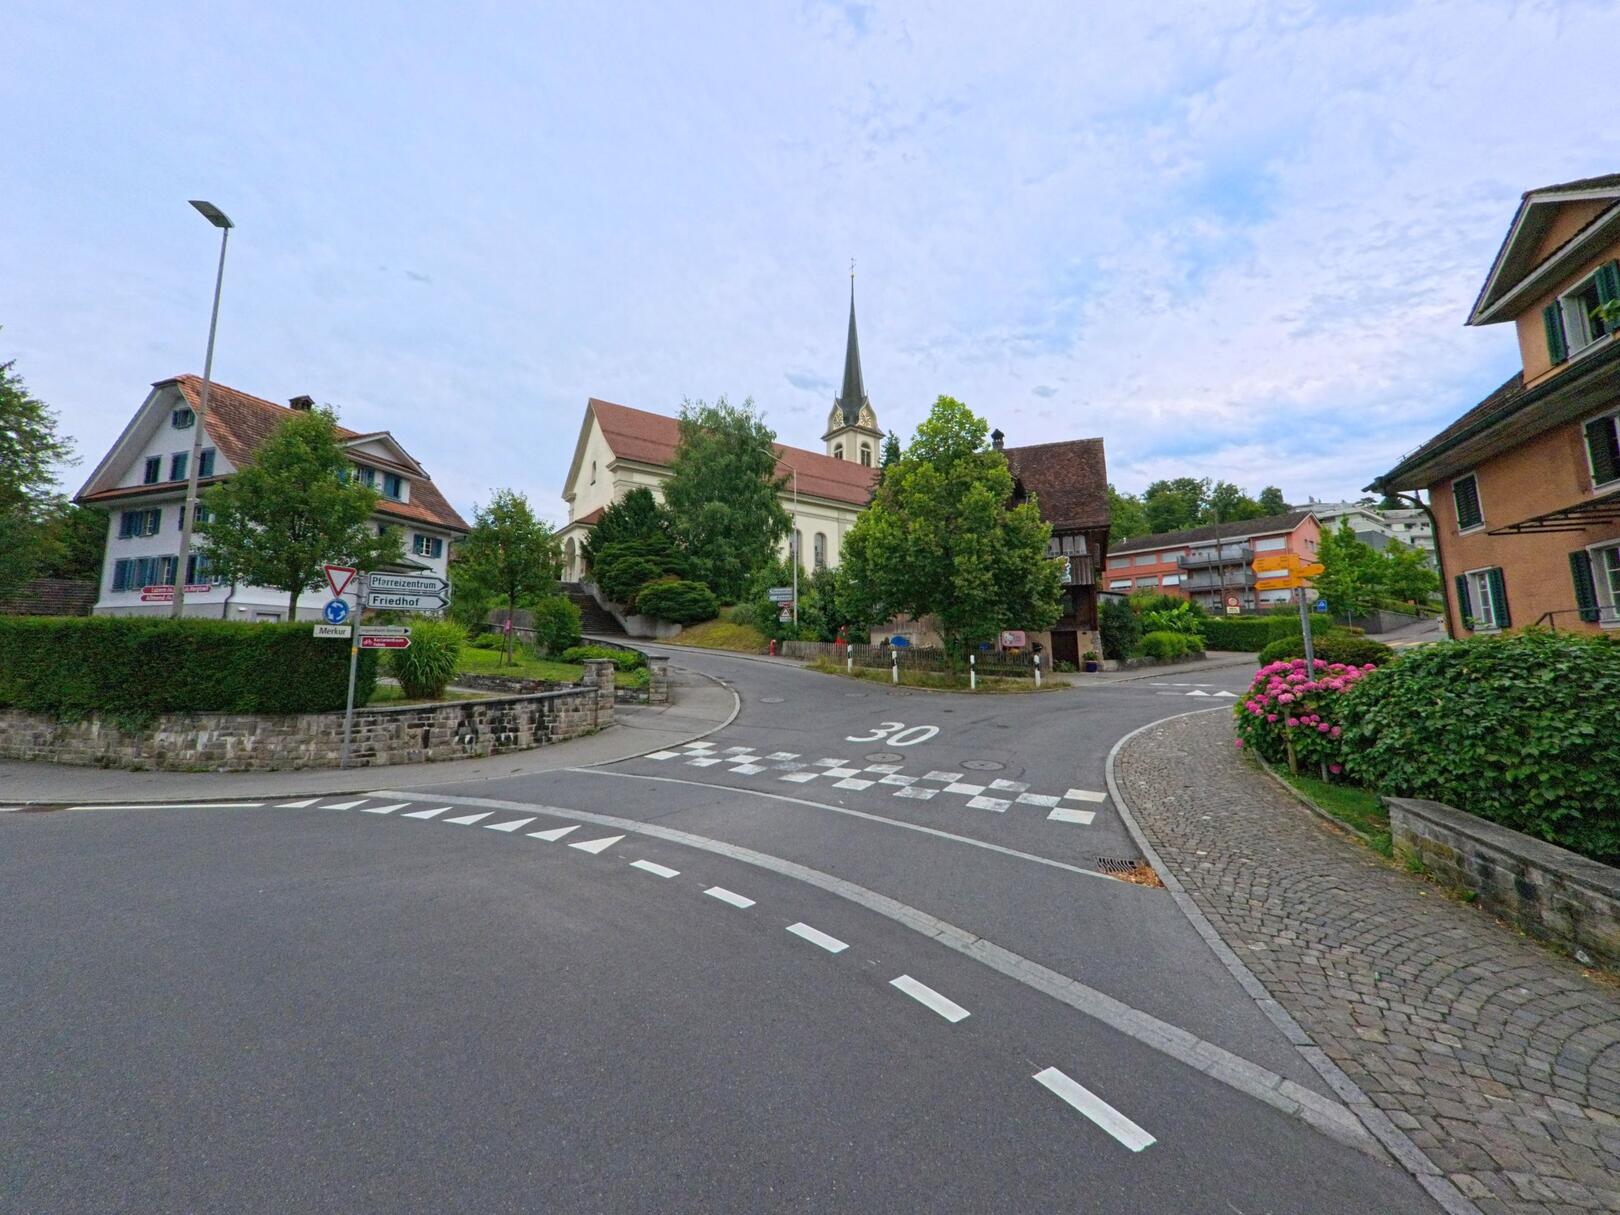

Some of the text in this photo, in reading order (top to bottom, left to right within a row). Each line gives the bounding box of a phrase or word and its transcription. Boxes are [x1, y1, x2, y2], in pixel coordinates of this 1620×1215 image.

[372, 576, 436, 589] Pfarreizentrum
[372, 595, 419, 606] Friedhof
[319, 627, 346, 635] Merkur
[845, 722, 939, 746] 30
